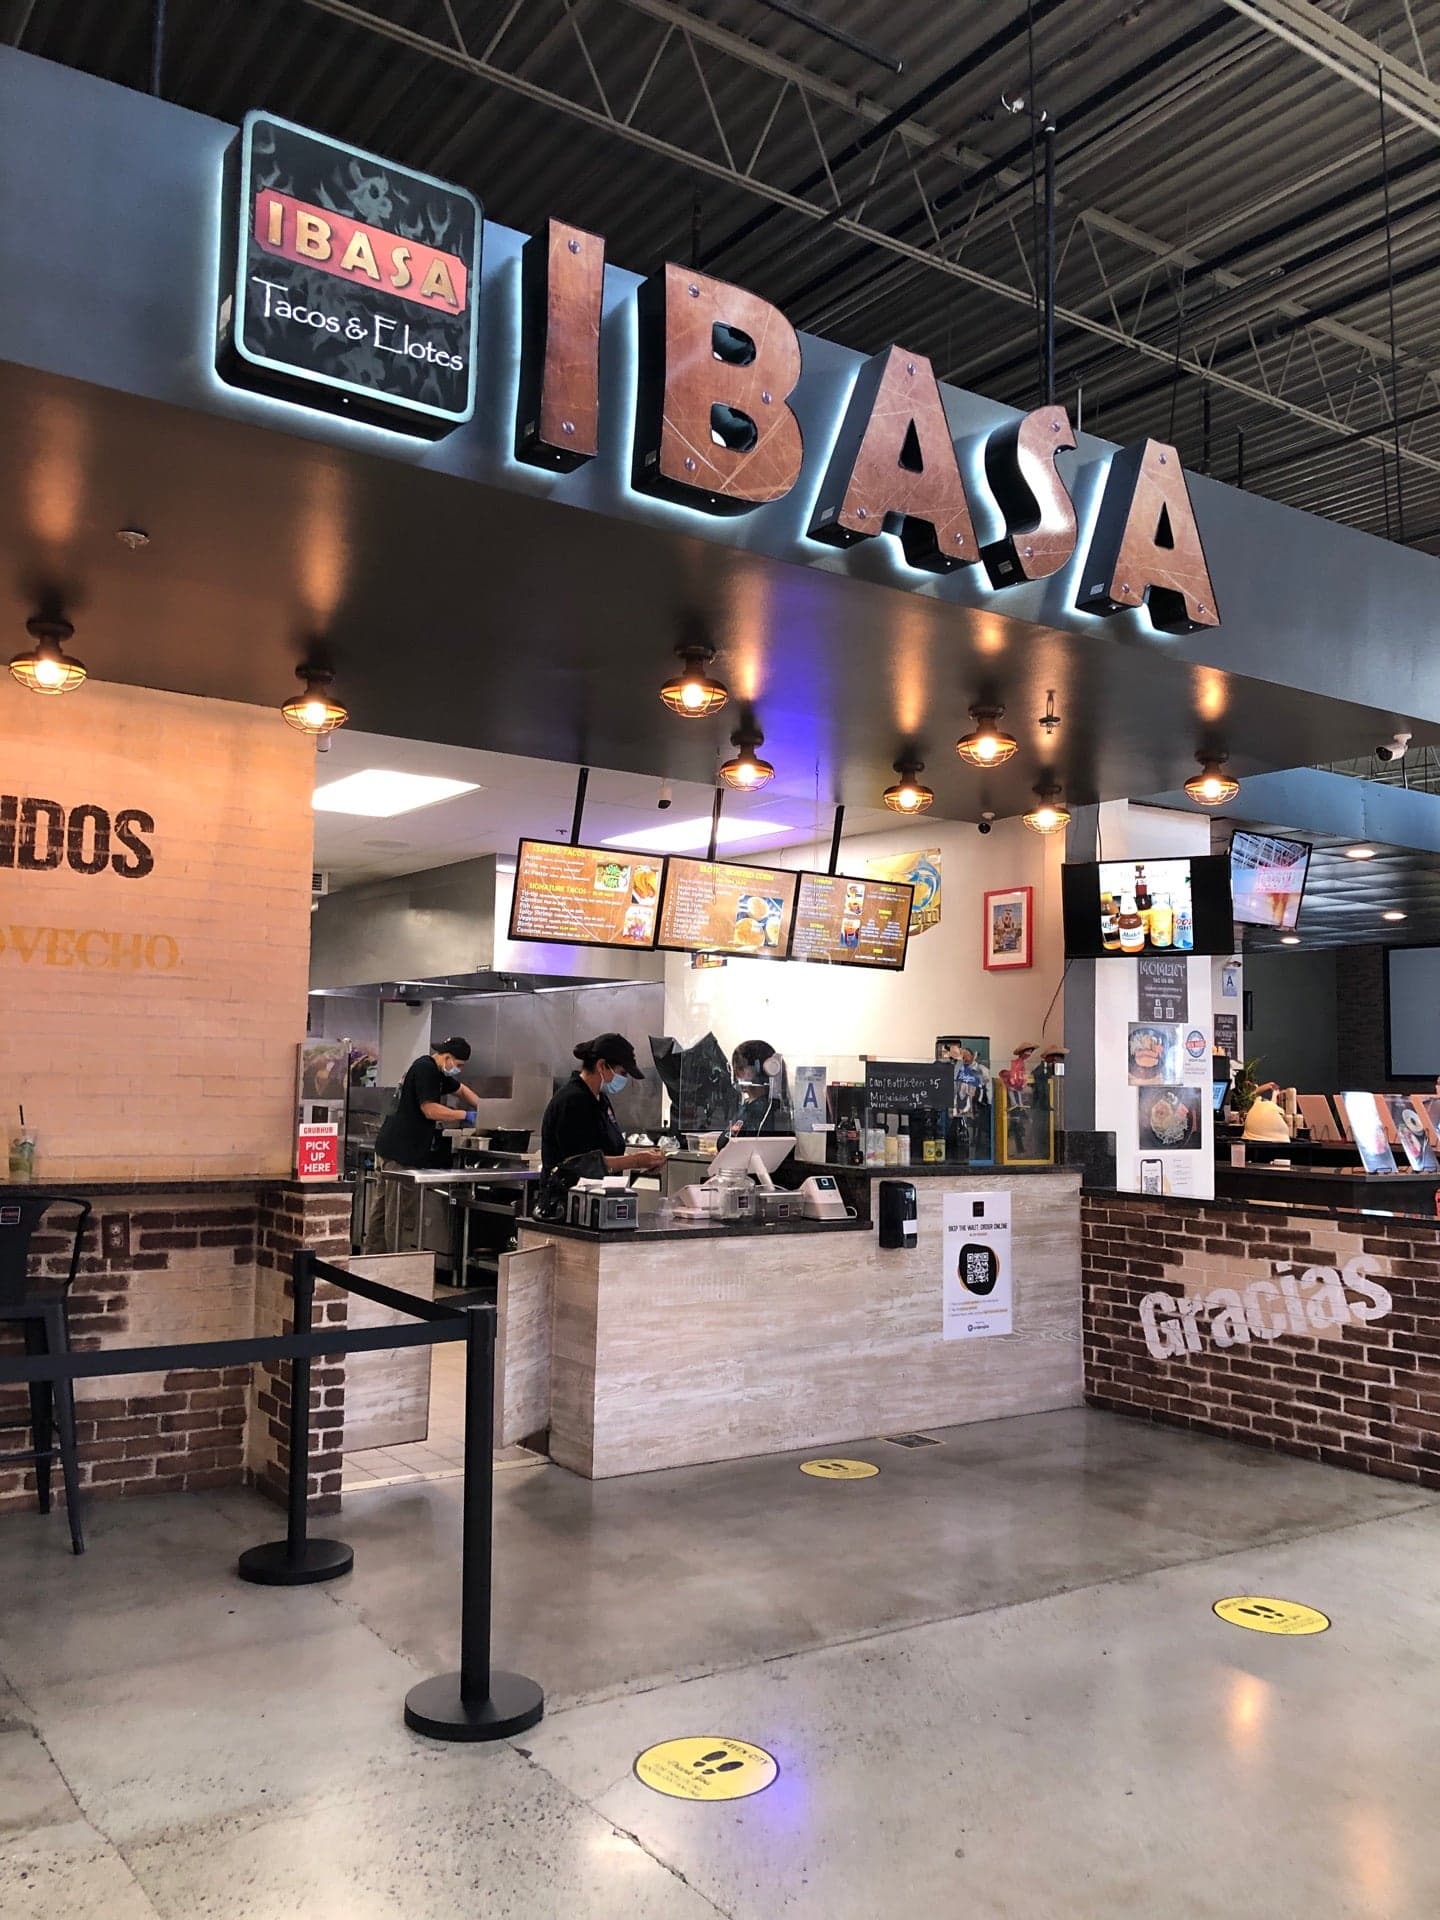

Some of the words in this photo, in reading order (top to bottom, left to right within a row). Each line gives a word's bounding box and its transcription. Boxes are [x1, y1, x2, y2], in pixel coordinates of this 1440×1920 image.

[266, 200, 458, 306] IBASA
[251, 275, 340, 333] Tacos
[344, 316, 368, 340] &
[373, 314, 464, 371] Elotes
[538, 216, 1221, 627] IBASA
[803, 1082, 819, 1108] A
[305, 1140, 330, 1150] PICK
[310, 1151, 325, 1162] UP
[303, 1163, 331, 1172] HERE
